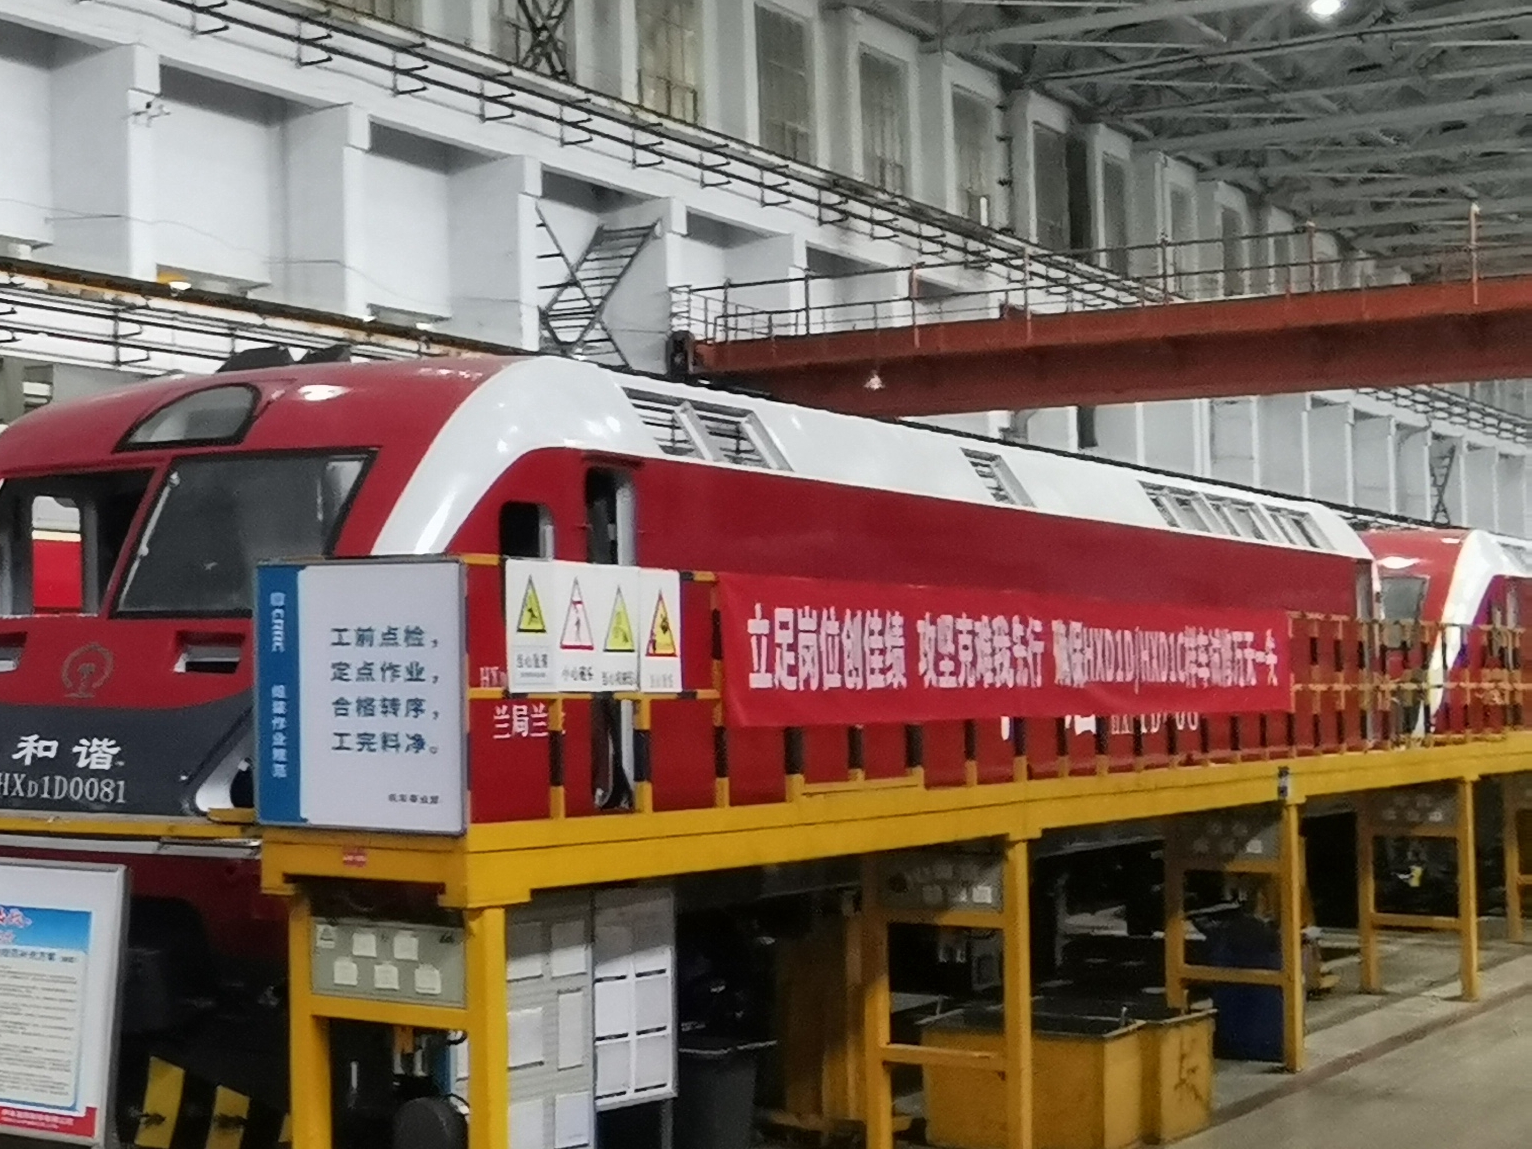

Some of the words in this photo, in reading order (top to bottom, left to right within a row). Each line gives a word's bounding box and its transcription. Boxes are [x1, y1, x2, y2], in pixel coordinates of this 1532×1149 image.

[747, 602, 908, 692] 立足岗位创佳绩
[493, 702, 567, 740] 兰局兰
[11, 733, 122, 771] 和谐
